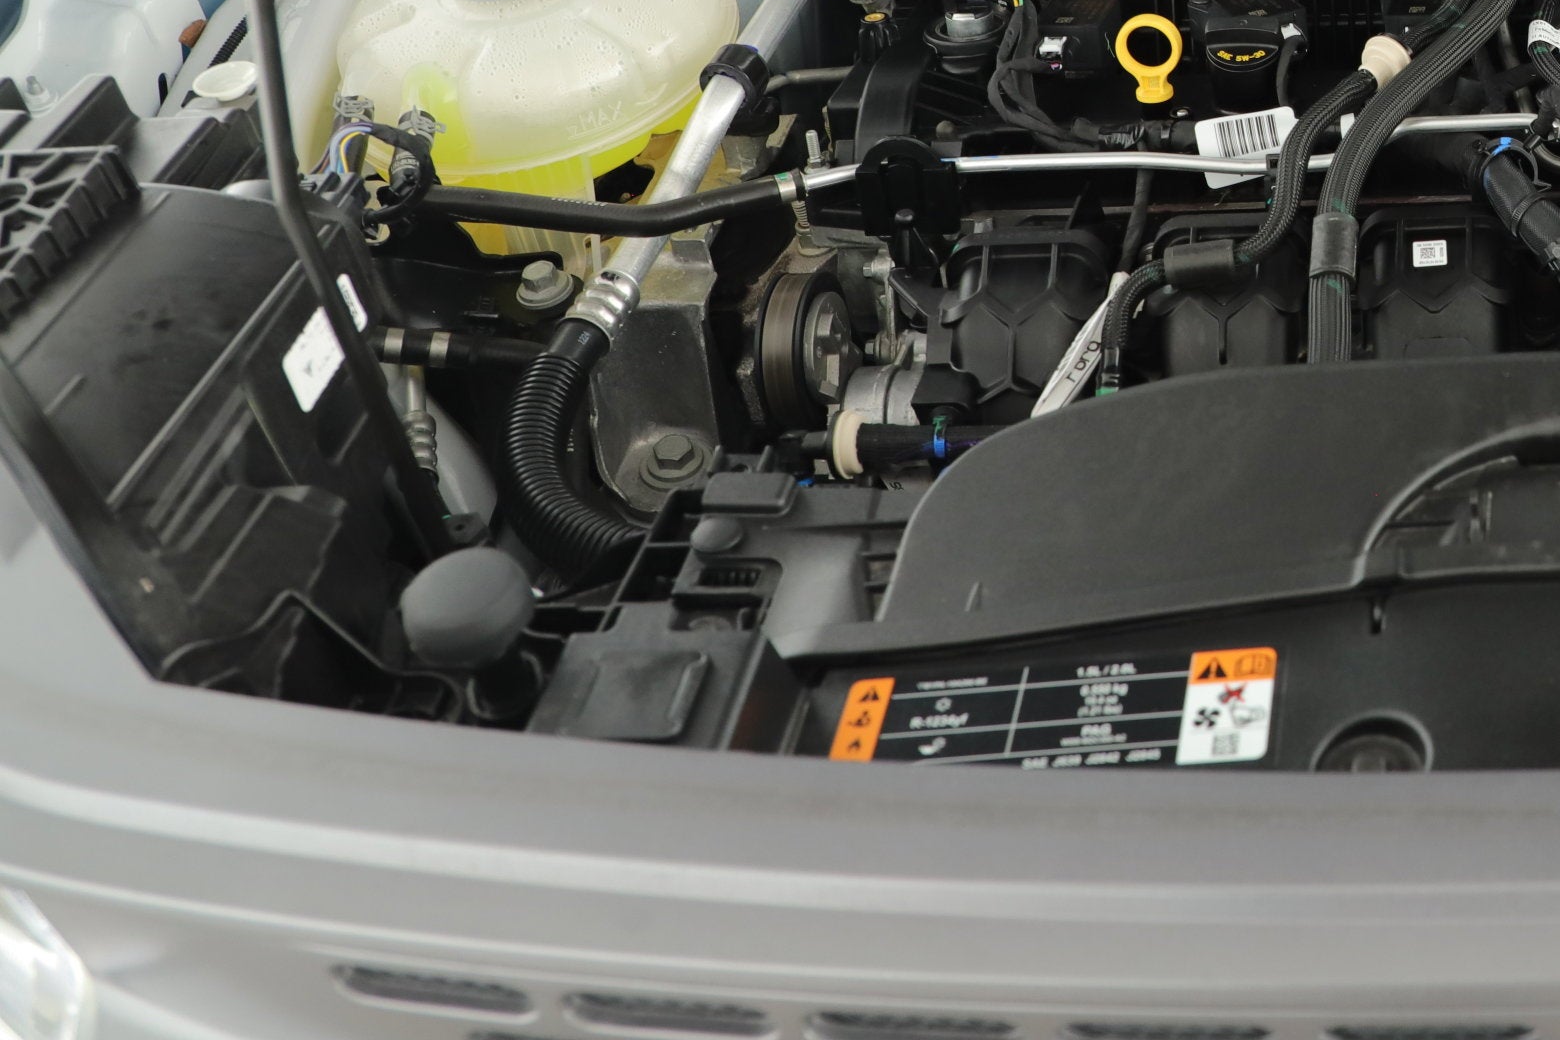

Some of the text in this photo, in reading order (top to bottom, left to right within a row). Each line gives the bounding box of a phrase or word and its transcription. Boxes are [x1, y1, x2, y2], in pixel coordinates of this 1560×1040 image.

[1217, 50, 1266, 62] SAE 5W-30
[578, 100, 629, 130] MAX
